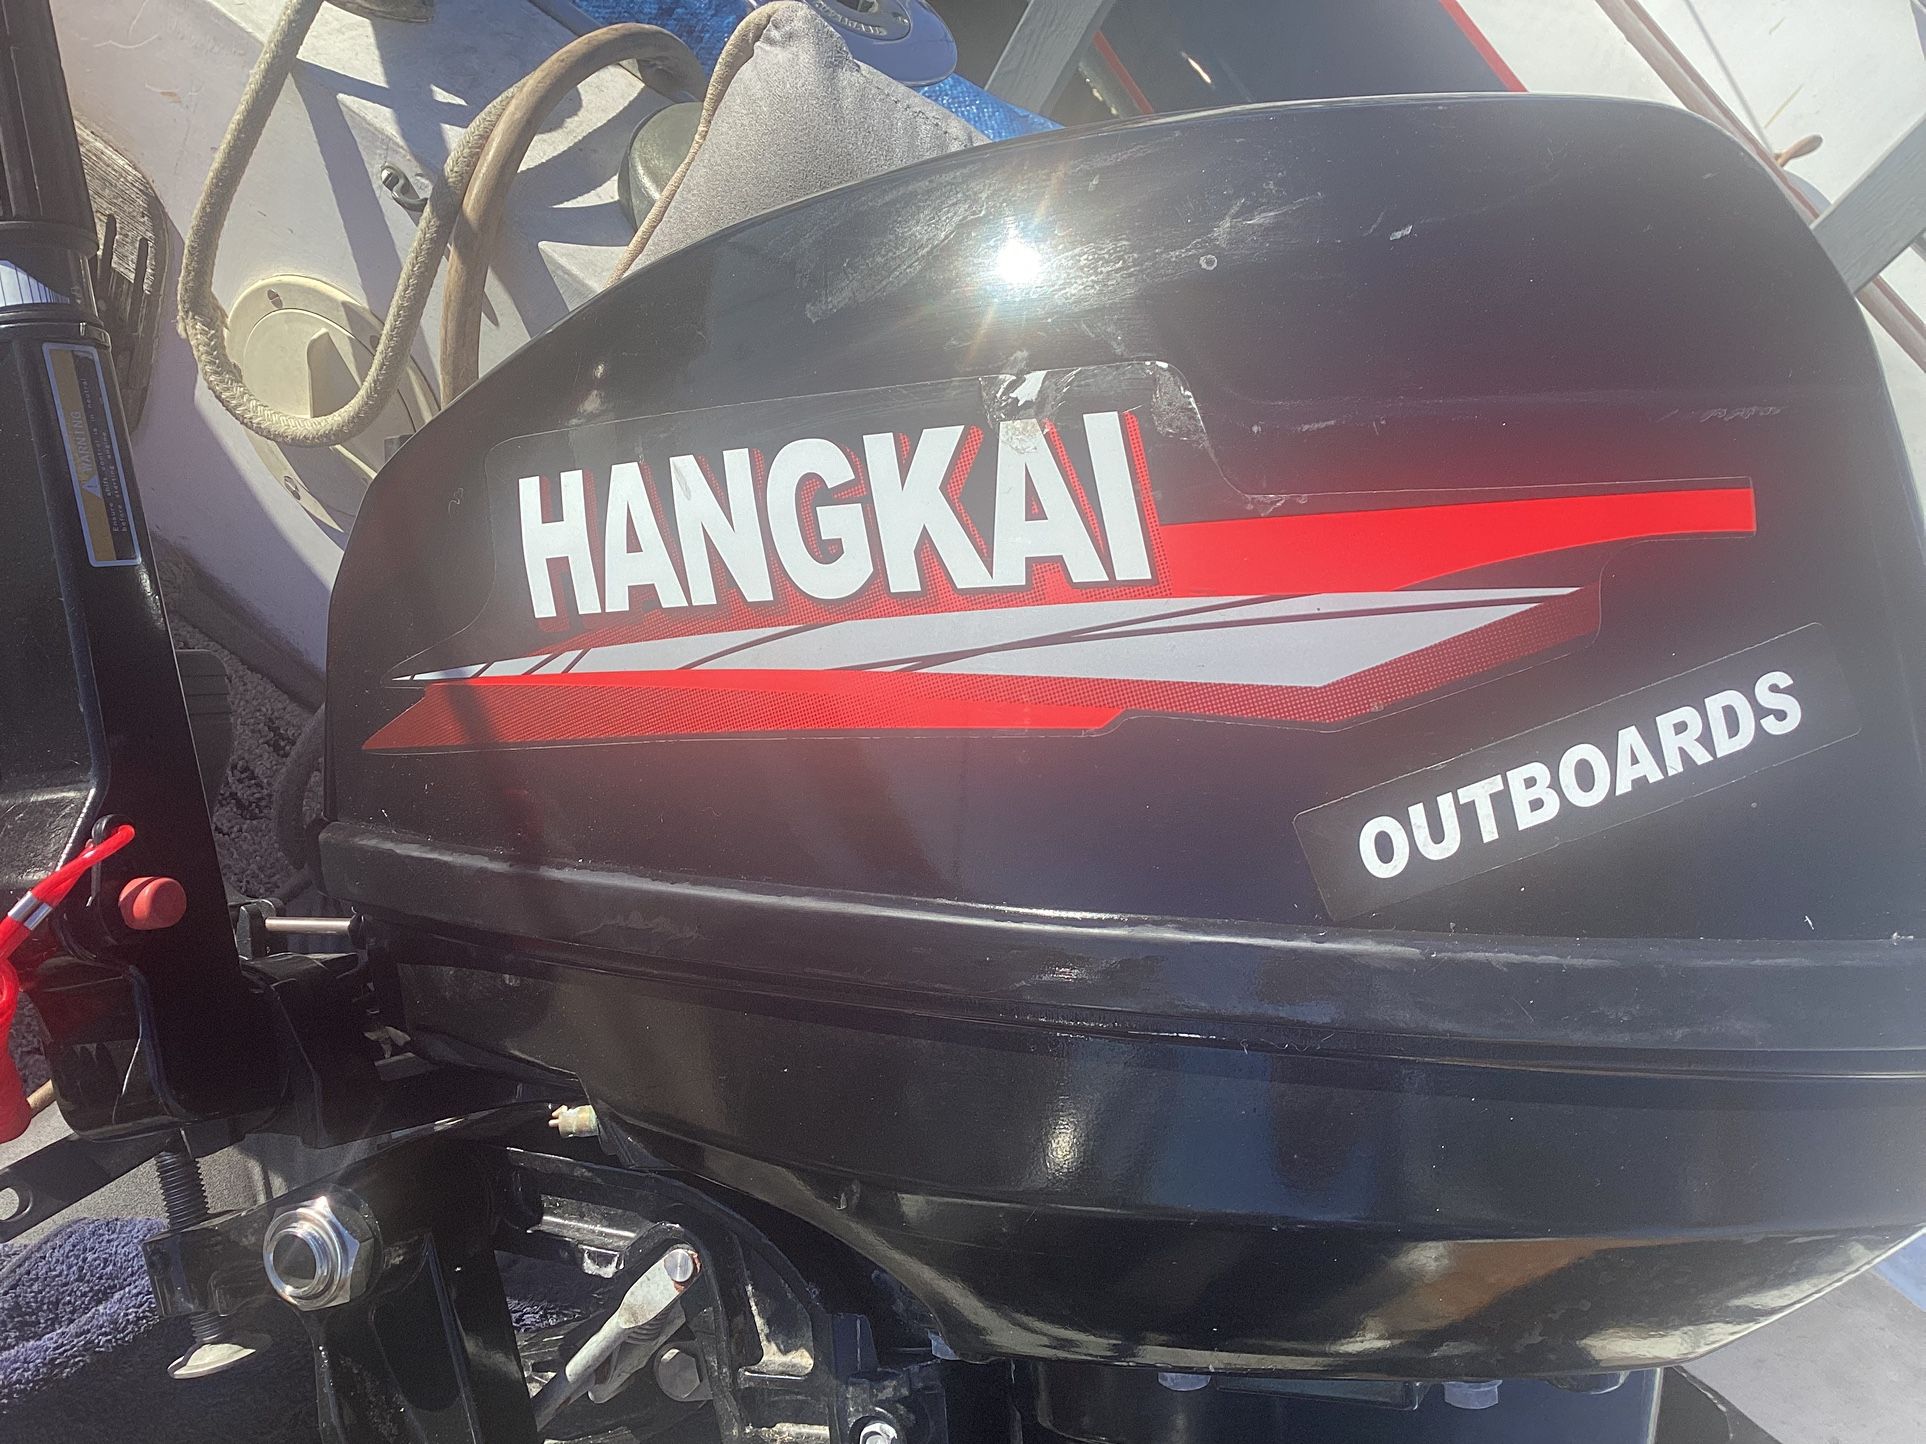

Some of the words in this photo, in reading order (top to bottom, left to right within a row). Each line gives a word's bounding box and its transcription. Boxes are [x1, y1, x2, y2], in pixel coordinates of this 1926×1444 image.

[71, 410, 93, 472] WARNING
[518, 411, 1153, 619] HANGKAI
[1358, 671, 1802, 879] OUTBOARDS
